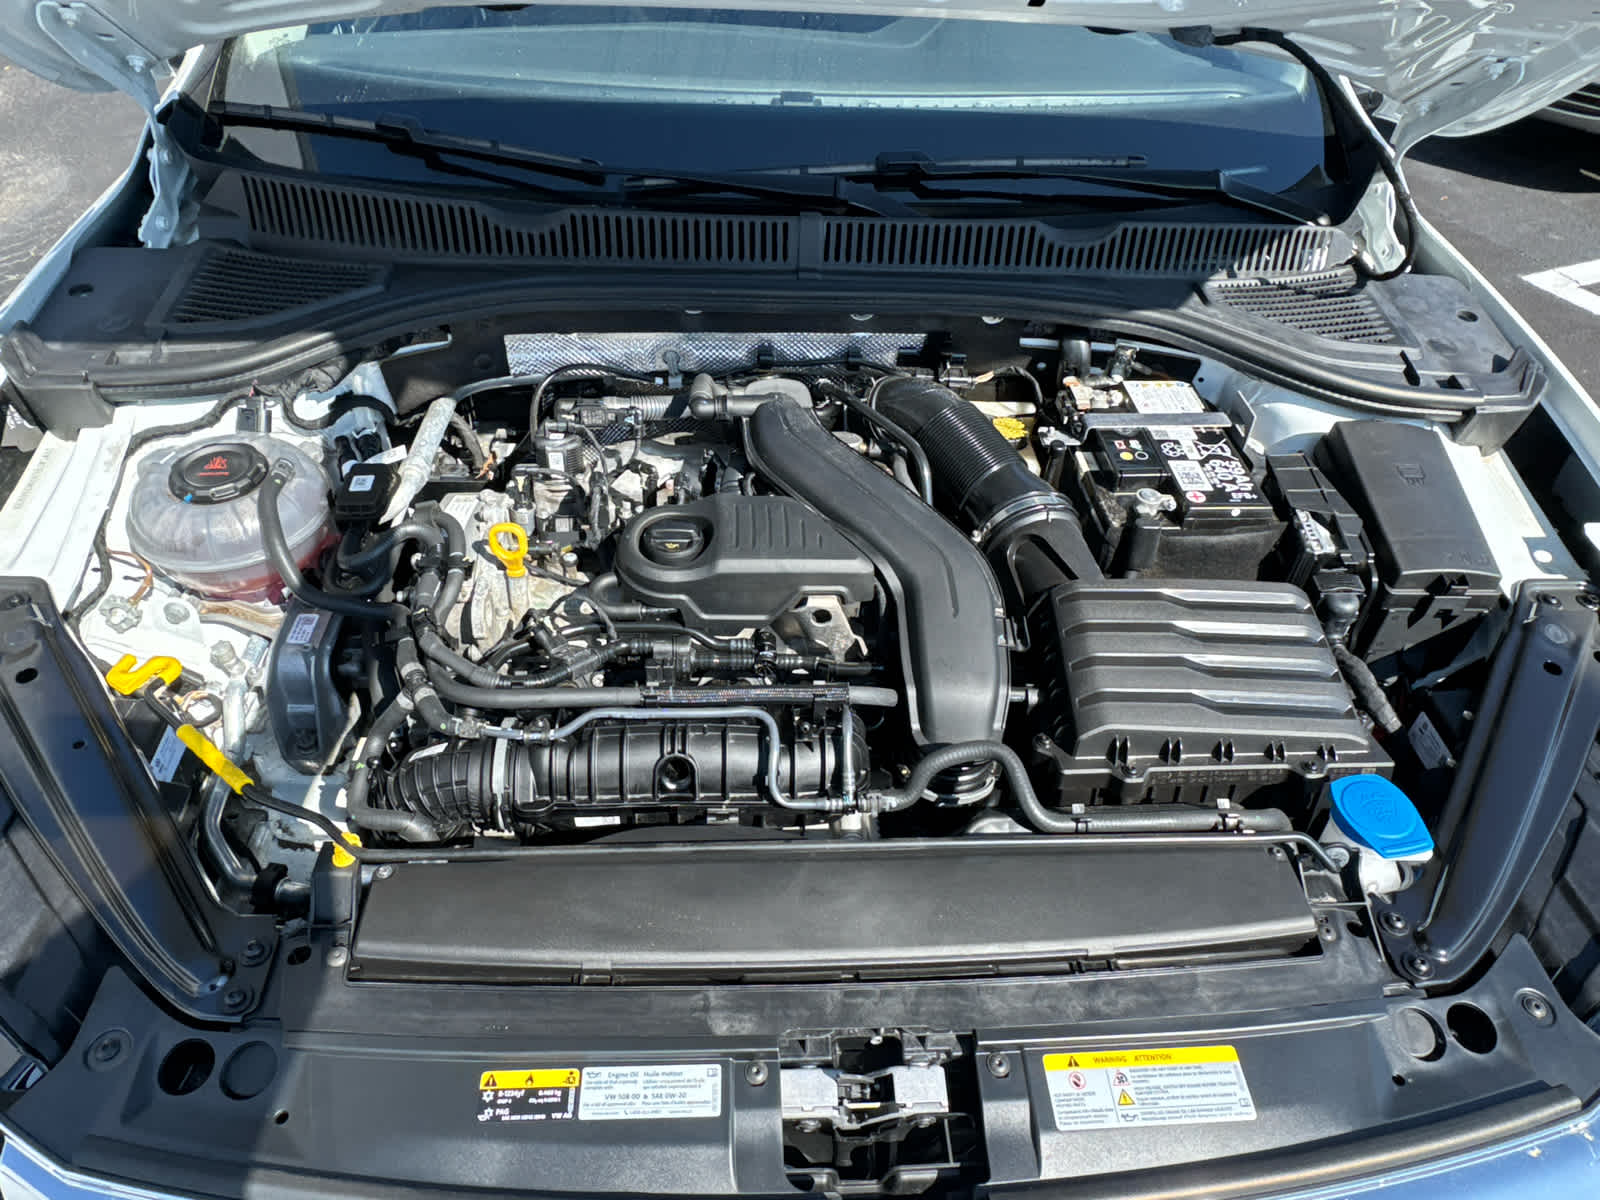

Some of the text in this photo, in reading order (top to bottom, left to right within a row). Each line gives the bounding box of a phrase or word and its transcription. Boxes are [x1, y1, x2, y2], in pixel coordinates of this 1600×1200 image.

[1224, 460, 1254, 491] 59Ah
[1093, 1053, 1172, 1064] WARNING ATTENTION
[607, 1071, 629, 1079] Engine
